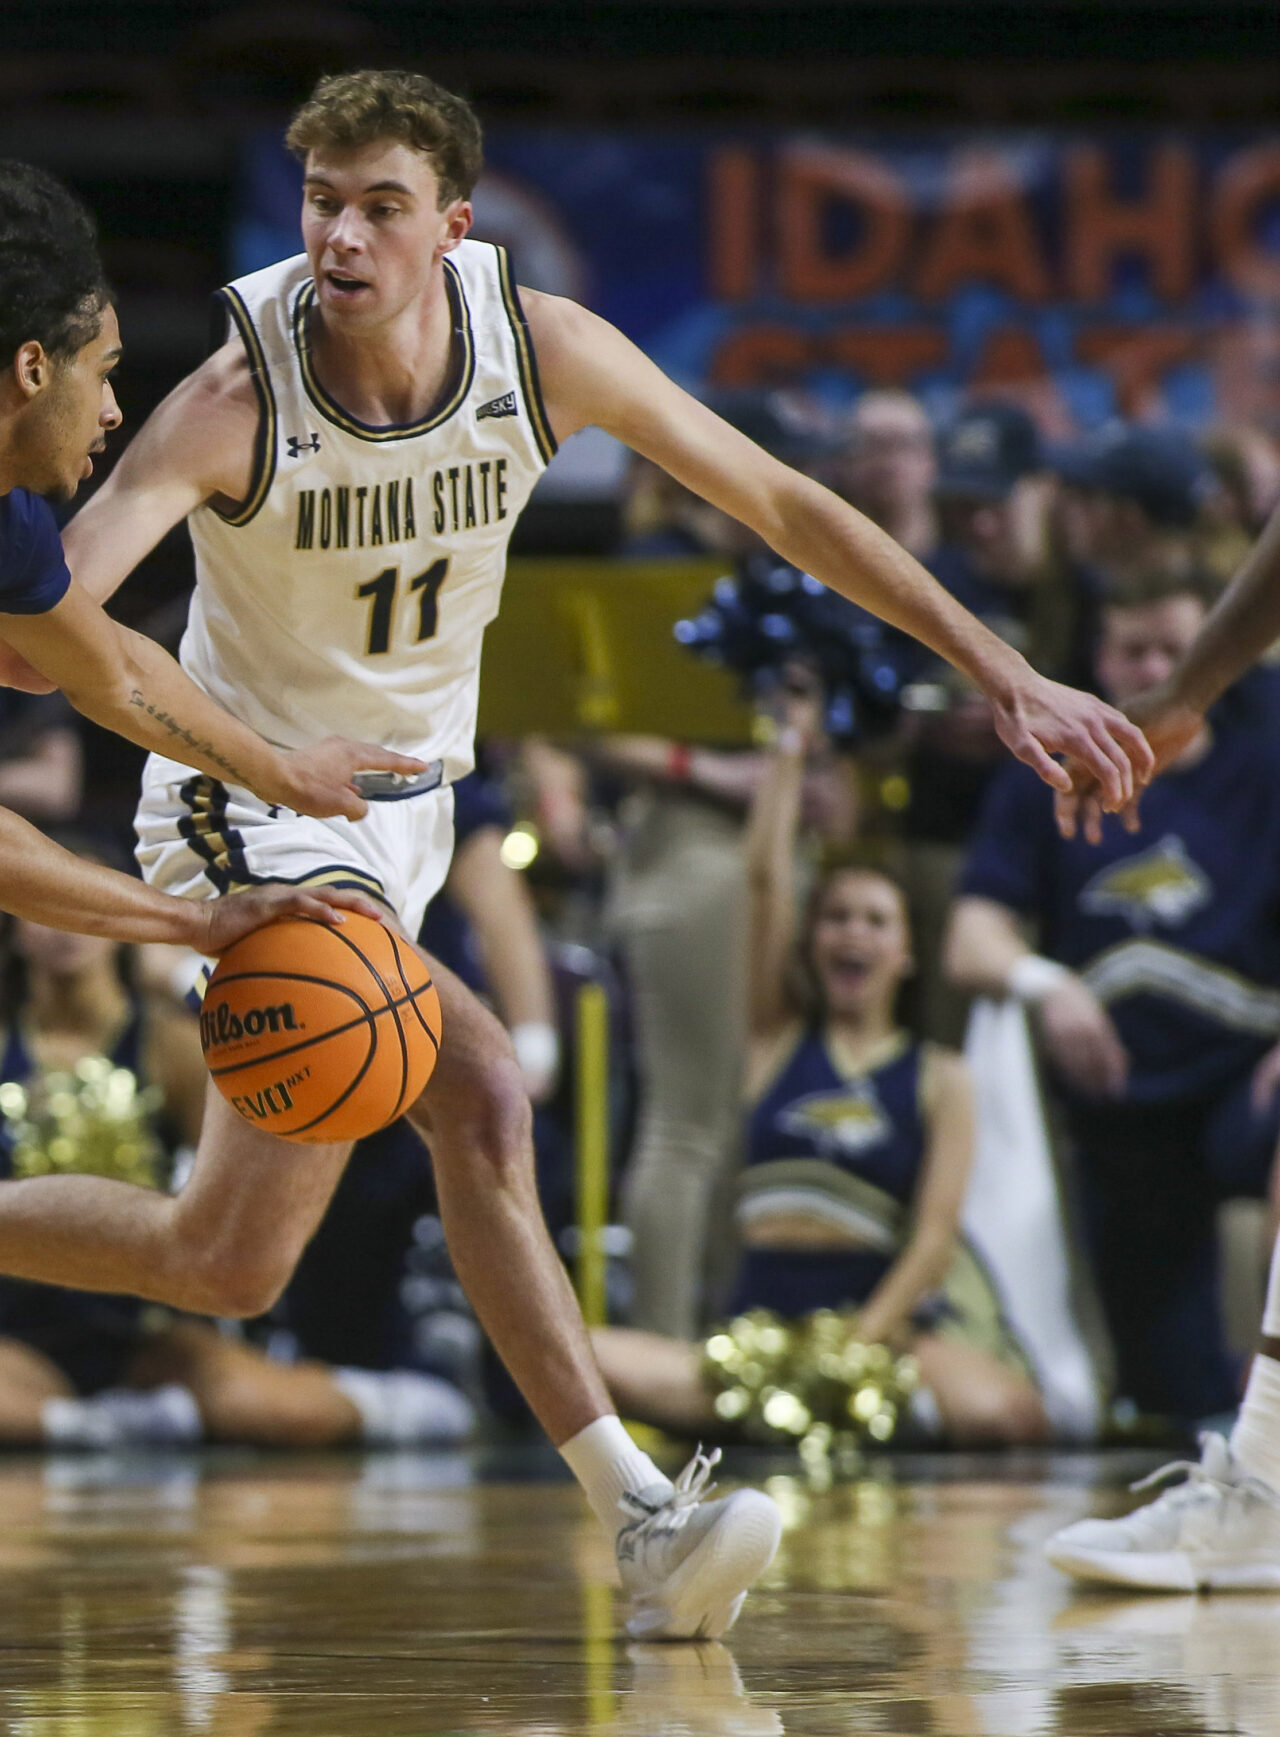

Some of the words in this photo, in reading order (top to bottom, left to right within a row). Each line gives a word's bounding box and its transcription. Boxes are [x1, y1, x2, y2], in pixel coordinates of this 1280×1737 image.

[295, 476, 416, 550] MONTANA
[433, 458, 508, 534] STATE
[353, 555, 452, 655] 11
